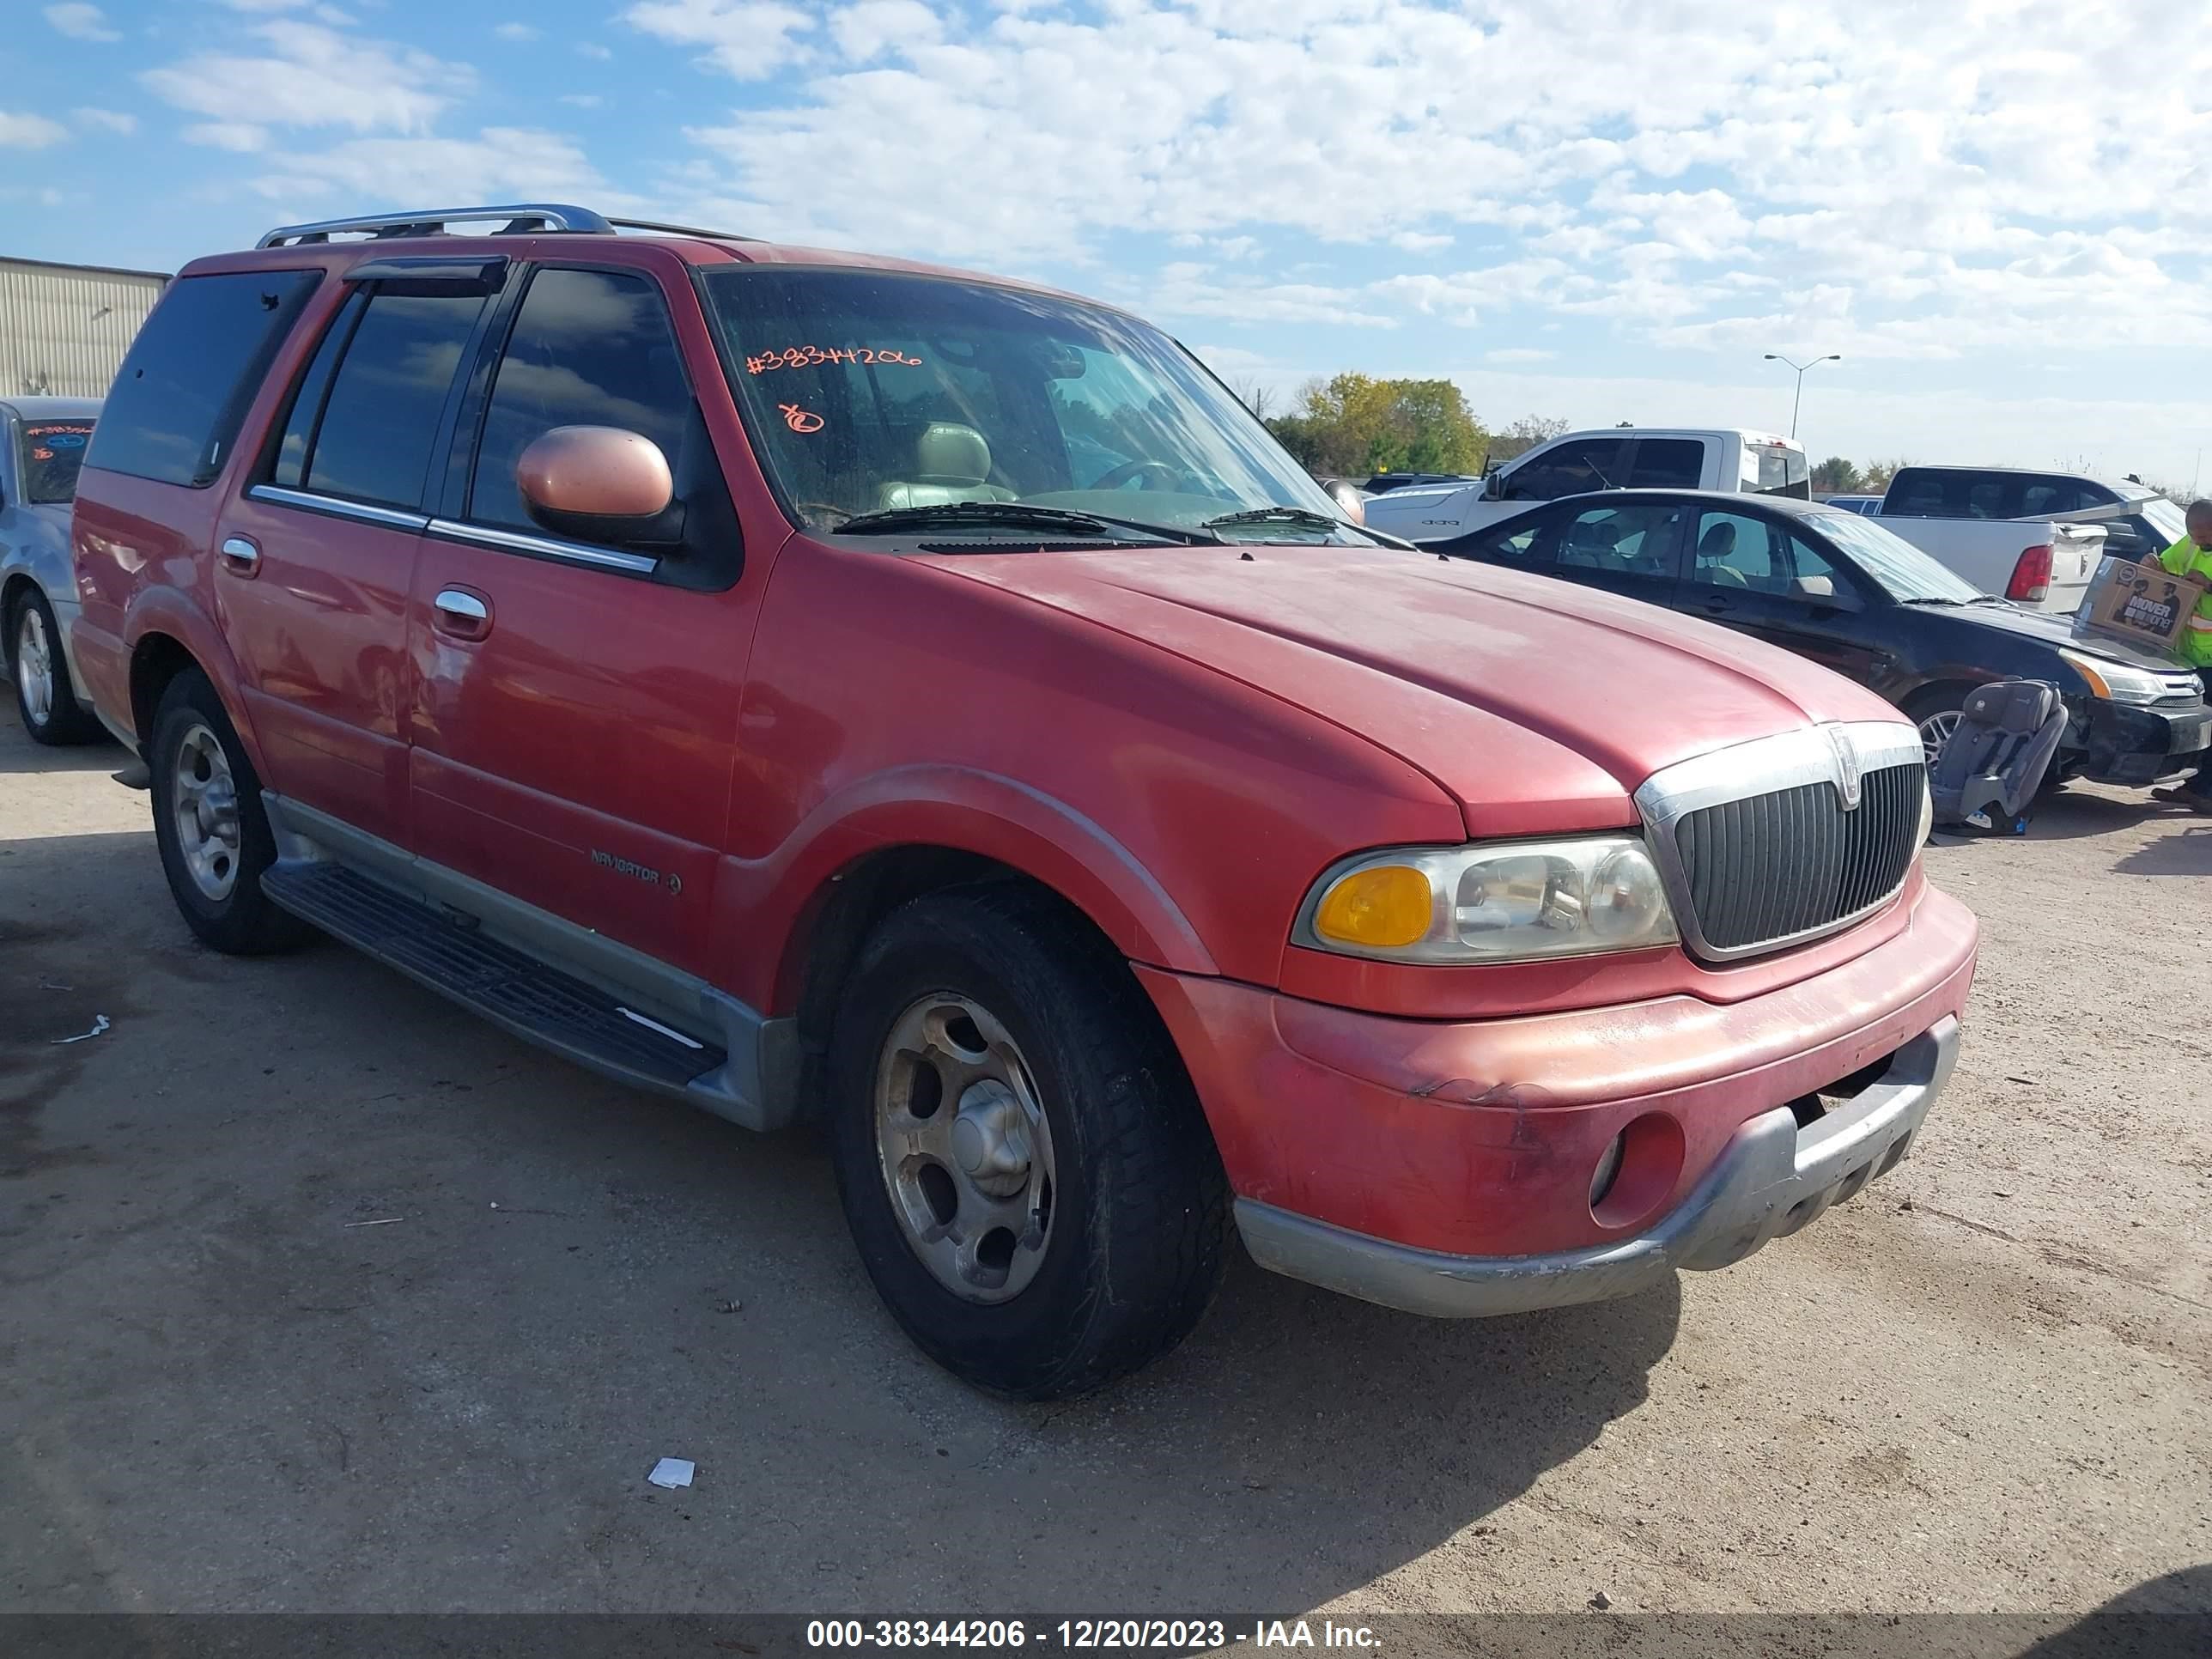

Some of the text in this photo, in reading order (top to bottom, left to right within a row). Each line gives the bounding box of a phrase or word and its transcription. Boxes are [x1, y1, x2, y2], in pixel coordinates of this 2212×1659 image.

[747, 345, 922, 374] #38344206
[2130, 596, 2171, 617] MOVER
[591, 848, 659, 884] NAVIGATOR
